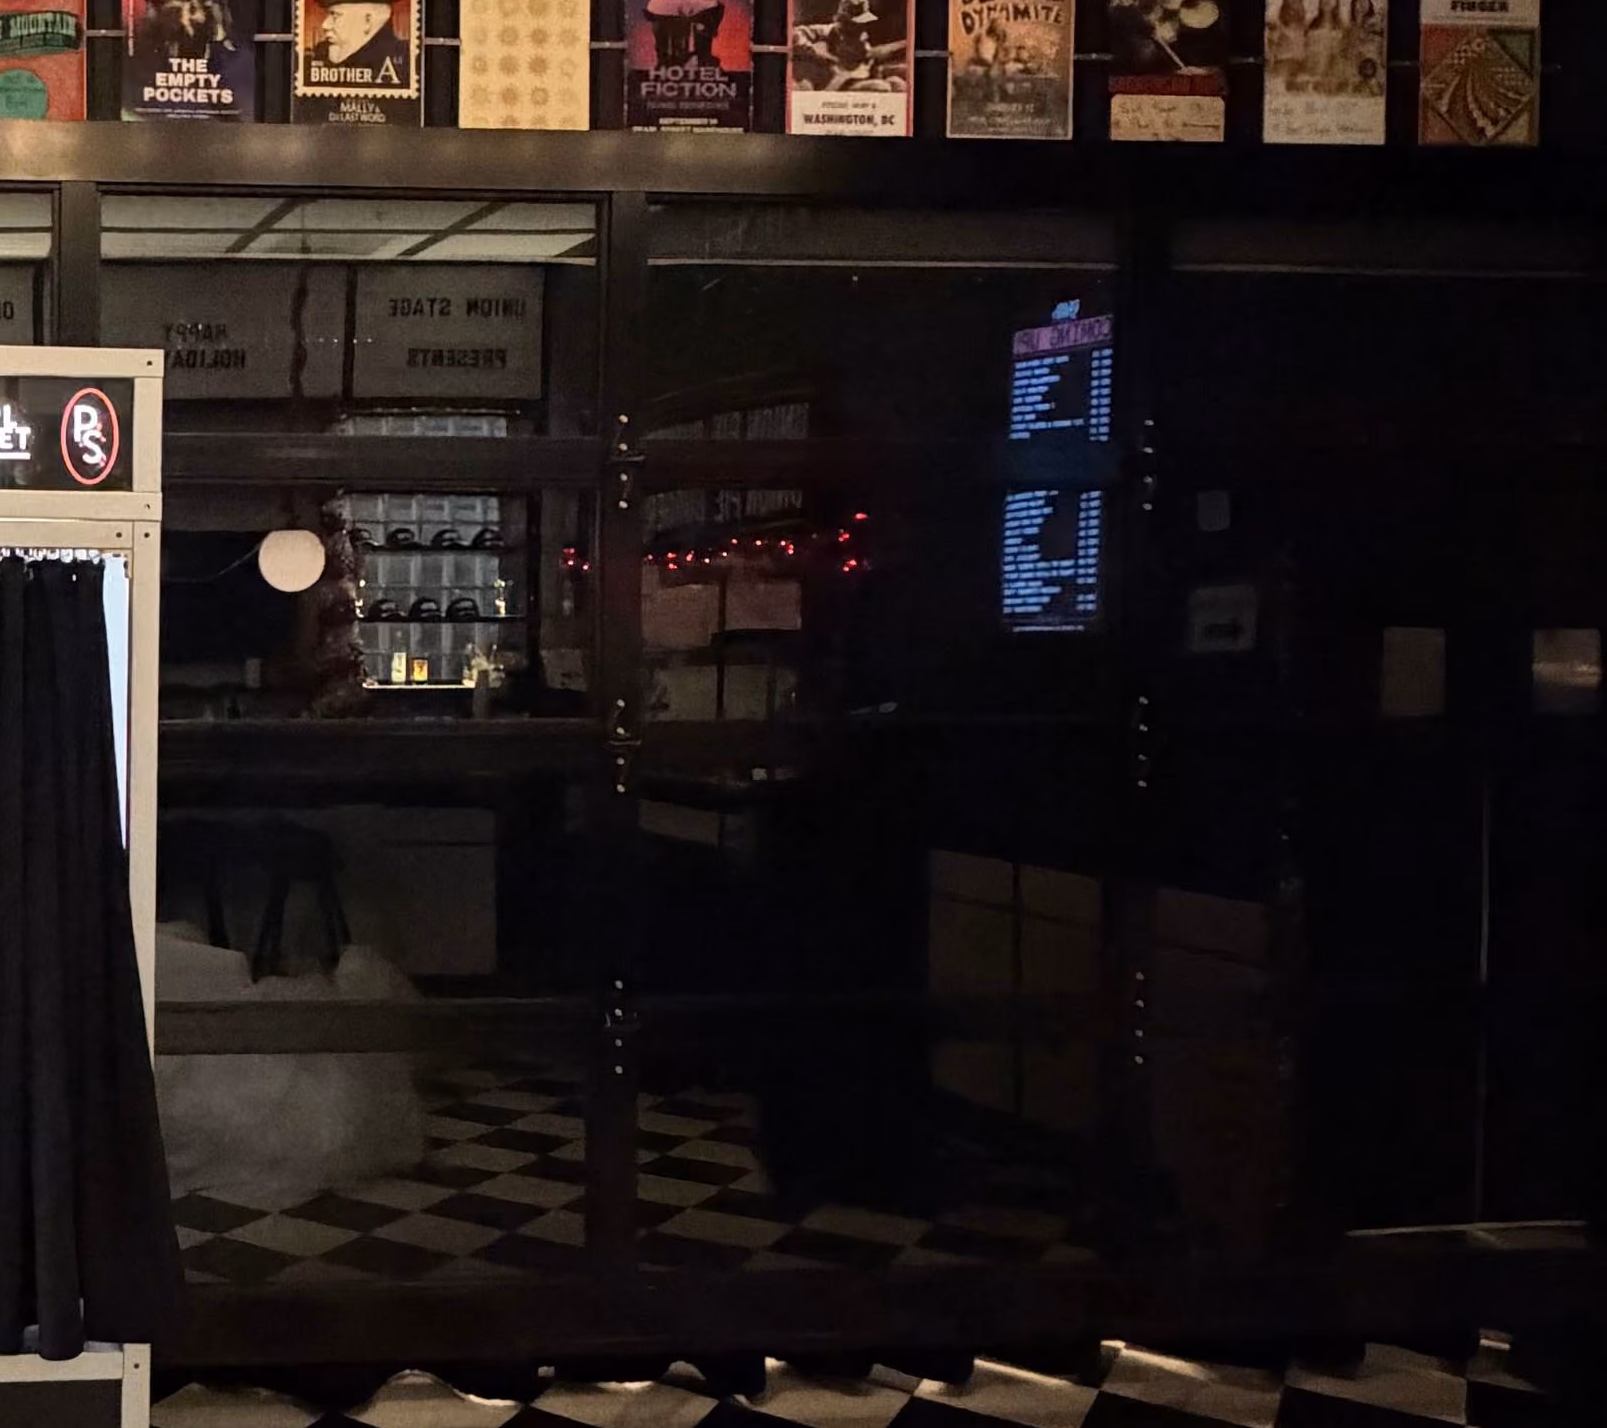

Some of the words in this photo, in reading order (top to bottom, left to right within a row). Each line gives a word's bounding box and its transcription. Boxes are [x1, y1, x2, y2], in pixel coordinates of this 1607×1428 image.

[960, 3, 1064, 36] DYNAMITE
[168, 58, 209, 73] THE
[648, 65, 729, 82] HOTEL
[155, 72, 221, 88] EMPTY
[310, 66, 373, 83] BROTHER
[144, 87, 234, 104] POCKETS
[640, 82, 738, 99] FICTION
[803, 113, 878, 128] WASHINGTON,
[881, 114, 896, 126] DC
